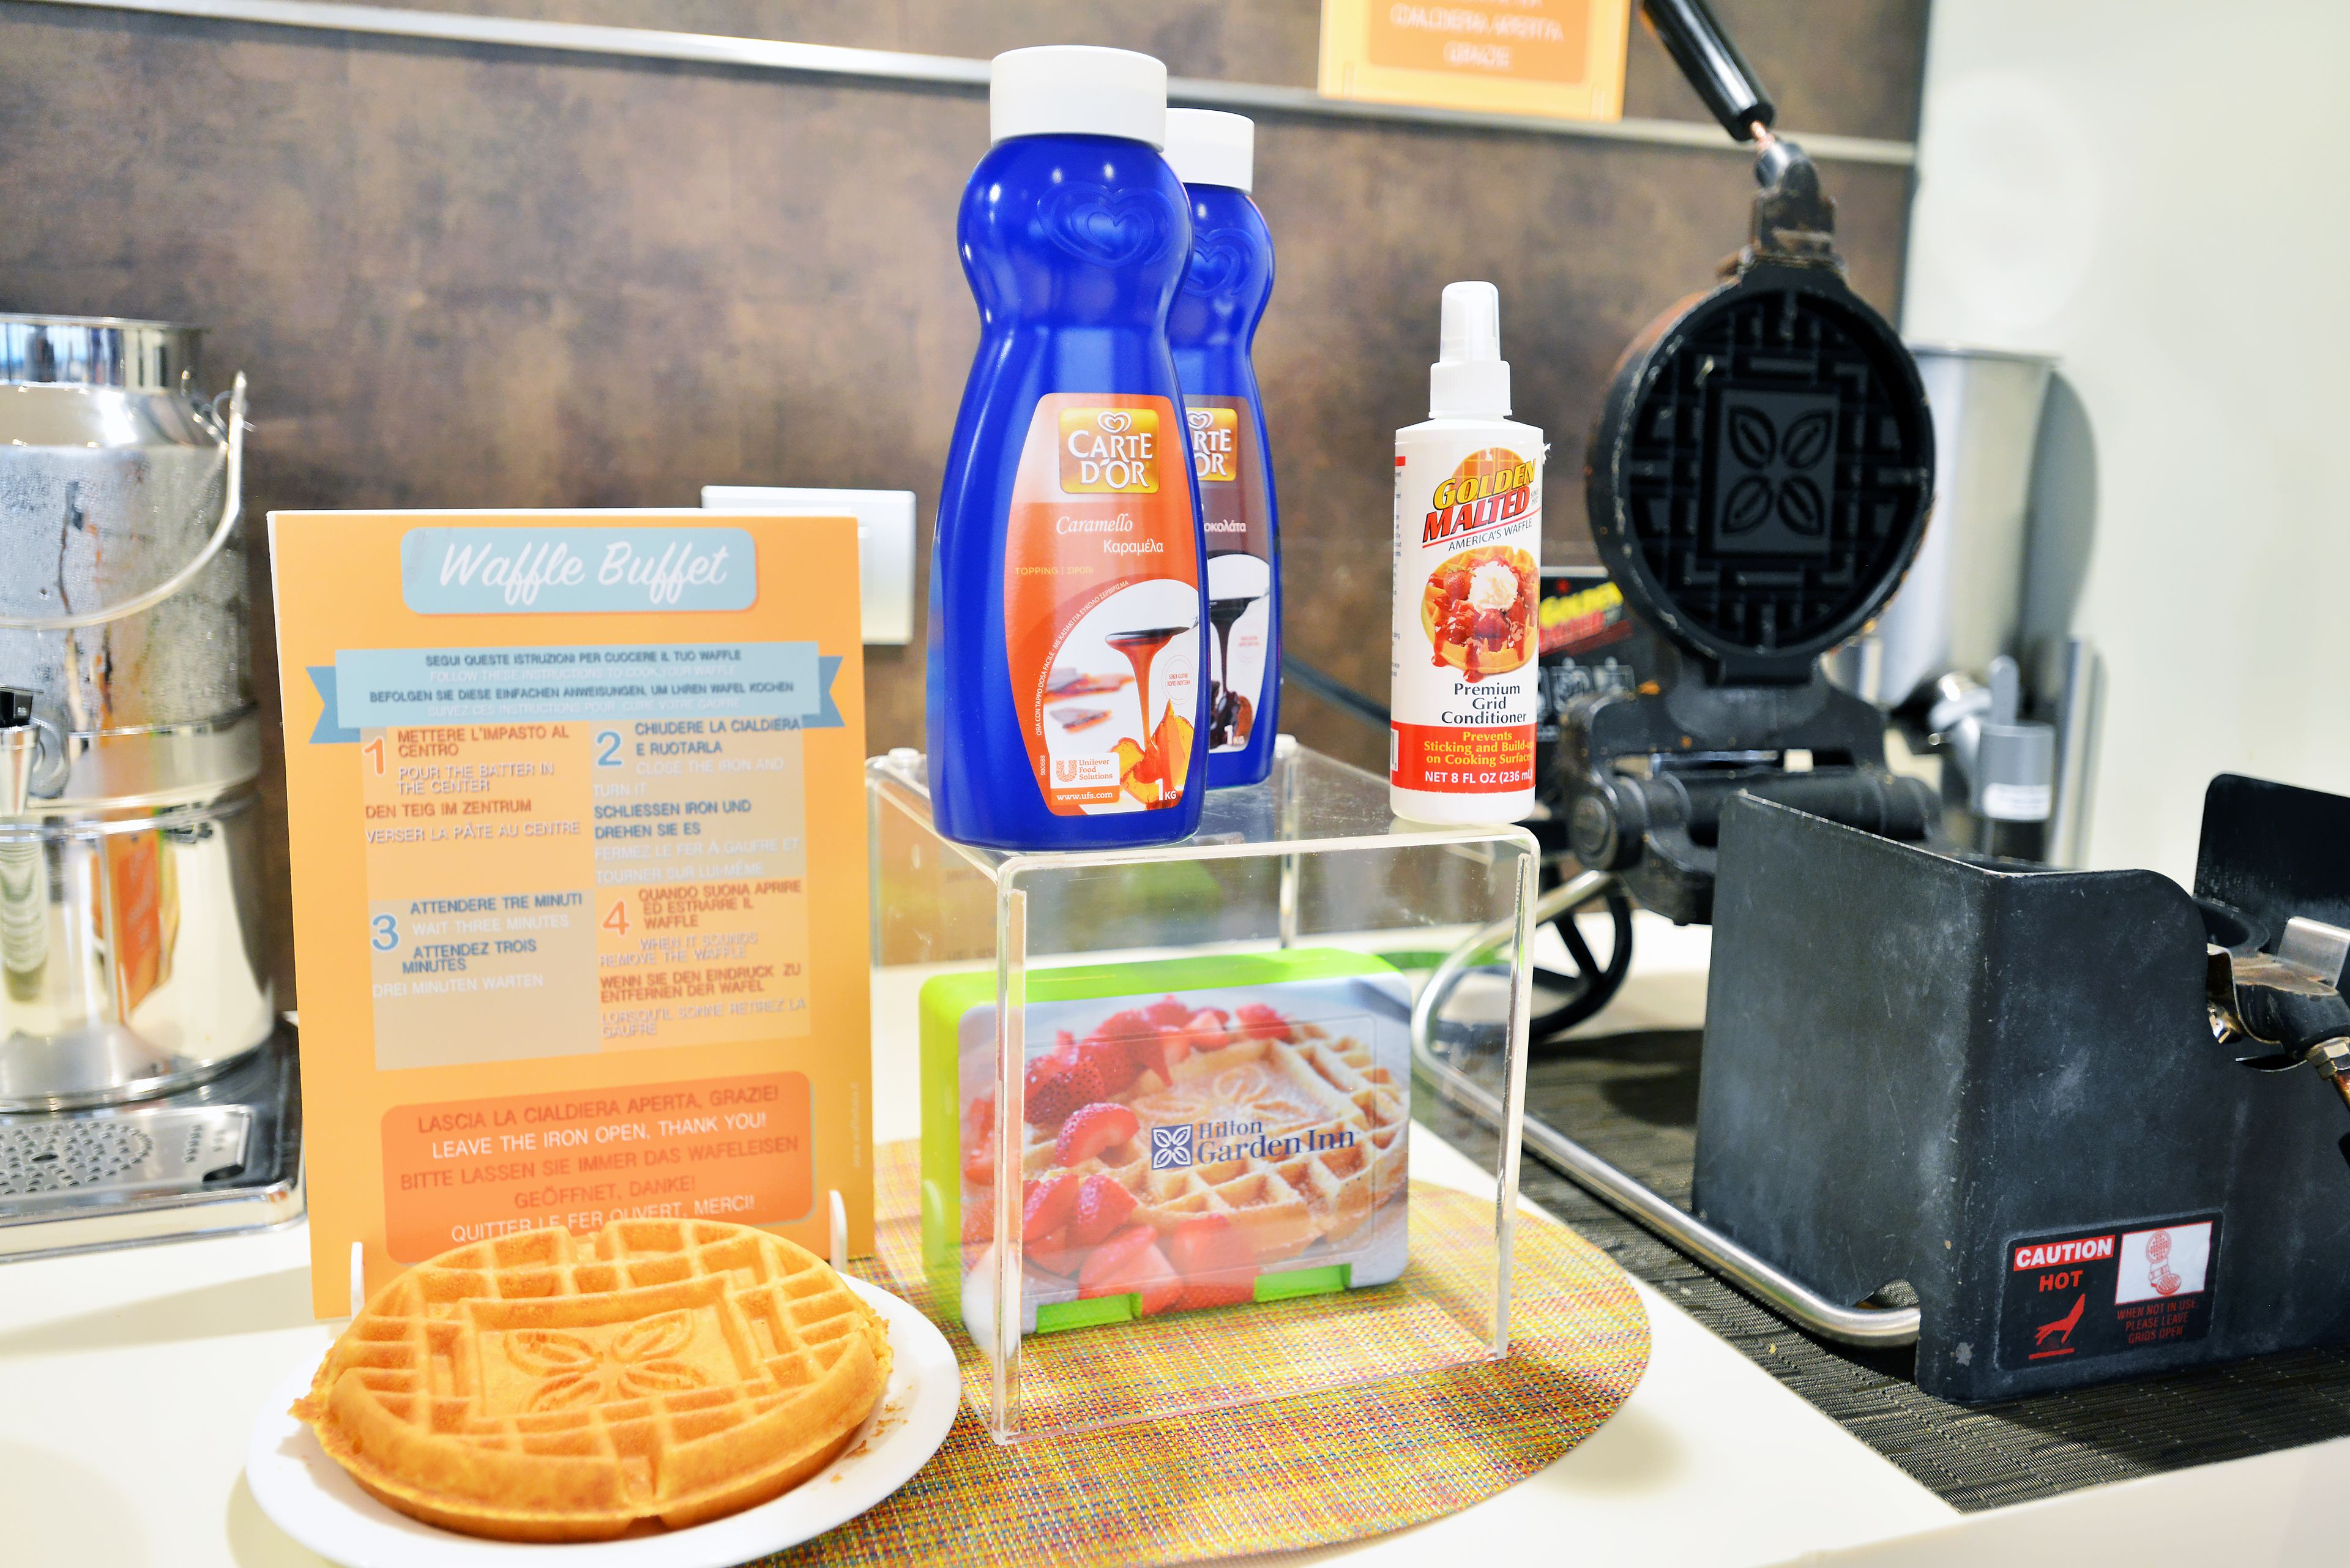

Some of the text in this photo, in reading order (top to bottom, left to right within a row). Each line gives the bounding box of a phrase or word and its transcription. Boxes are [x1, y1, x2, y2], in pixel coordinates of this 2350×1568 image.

[1068, 429, 1153, 463] CARTE
[1193, 428, 1232, 455] RTE
[1081, 458, 1149, 489] D'OR
[1194, 452, 1227, 477] OR
[1433, 458, 1536, 510] GOLDEN
[1056, 513, 1133, 535] Caramello
[1204, 519, 1247, 532] οκολάτα
[1422, 486, 1530, 543] MALTED
[1449, 518, 1532, 551] AMERICA'S WAFFLE
[1103, 539, 1163, 556] Καραμέλα
[439, 541, 729, 606] Waffle Buffet
[1015, 567, 1058, 575] TOPPING
[426, 649, 741, 666] SEGUI QUESTE ISTRUZIONI PER CUOCERE IL TUO WAFFLE
[1038, 671, 1047, 688] DOSA
[1043, 651, 1054, 671] FACILE
[370, 690, 432, 703] BEFOLGEN
[436, 689, 453, 701] SIE
[459, 688, 490, 700] DIESE
[496, 687, 559, 700] EINFACHEN
[651, 684, 667, 695] UM
[710, 682, 745, 693] WAFEL
[750, 681, 794, 693] KOCHEN
[1454, 682, 1520, 695] Premium
[1472, 696, 1506, 710] Grid
[635, 718, 800, 736] CHIUDERE LA CIALDIERA
[1441, 711, 1527, 724] Conditioner
[398, 725, 569, 742] METTERE L'IMPASTO AL
[1463, 731, 1512, 741] Prevents
[363, 736, 385, 775] 1
[398, 743, 459, 758] CENTRO
[596, 730, 623, 767] 2
[636, 741, 723, 756] E RUOTARLA
[1424, 741, 1472, 755] Sticking
[1475, 742, 1498, 753] and
[399, 762, 554, 780] POUR THE BATTER IN
[1426, 755, 1441, 764] on
[1445, 754, 1496, 767] Cooking
[398, 778, 490, 795] THE CENTER
[1425, 771, 1448, 783] NET
[1451, 772, 1459, 783] 8
[1463, 772, 1476, 783] FL
[1479, 772, 1496, 783] OZ
[1499, 771, 1520, 784] (236
[1056, 791, 1113, 801] www.ufs.com
[1155, 778, 1176, 801] 1 KG
[365, 799, 532, 819] DEN TEIG IM ZENTRUM
[594, 799, 752, 819] SCHLIESSEN IRON UND
[366, 827, 424, 843] VERSER
[430, 826, 448, 841] LA
[498, 823, 518, 838] AU
[523, 821, 580, 837] CENTRE
[595, 822, 701, 839] DREHEN SIE ES
[411, 893, 582, 915] ATTENDERE TRE MINUTI
[412, 914, 569, 936] WAIT THREE MINUTES
[602, 900, 630, 936] 4
[371, 914, 400, 952] 3
[414, 939, 537, 959] ATTENDEZ TROIS
[402, 958, 466, 974] MINUTES
[600, 962, 801, 990] WENN SIE DEN EINDRUCK ZU
[372, 973, 543, 999] DREI MINUTEN WARTEN
[601, 979, 764, 1004] ENTFERNEN DER WAFEL
[417, 1111, 487, 1133] LASCIA
[493, 1109, 517, 1127] LA
[524, 1099, 621, 1124] CIALDIERA
[432, 1137, 492, 1159] LEAVE
[499, 1132, 537, 1152] THE
[543, 1128, 589, 1148] IRON
[657, 1115, 718, 1137] THANK
[725, 1111, 767, 1130] YOU!
[1198, 1120, 1263, 1140] Hilton
[1196, 1129, 1356, 1165] Garden Inn
[400, 1135, 799, 1190] BITTE LASSEN SIE IMMER DAS WAFELEISEN
[2016, 1237, 2112, 1267] CAUTION
[2039, 1270, 2083, 1293] HOT
[2117, 1306, 2144, 1320] WHEN
[2147, 1303, 2164, 1315] NOT
[2167, 1301, 2176, 1312] IN
[2125, 1312, 2188, 1332] PLEASE LEAVE
[2128, 1326, 2183, 1345] GRIDS OPEN
